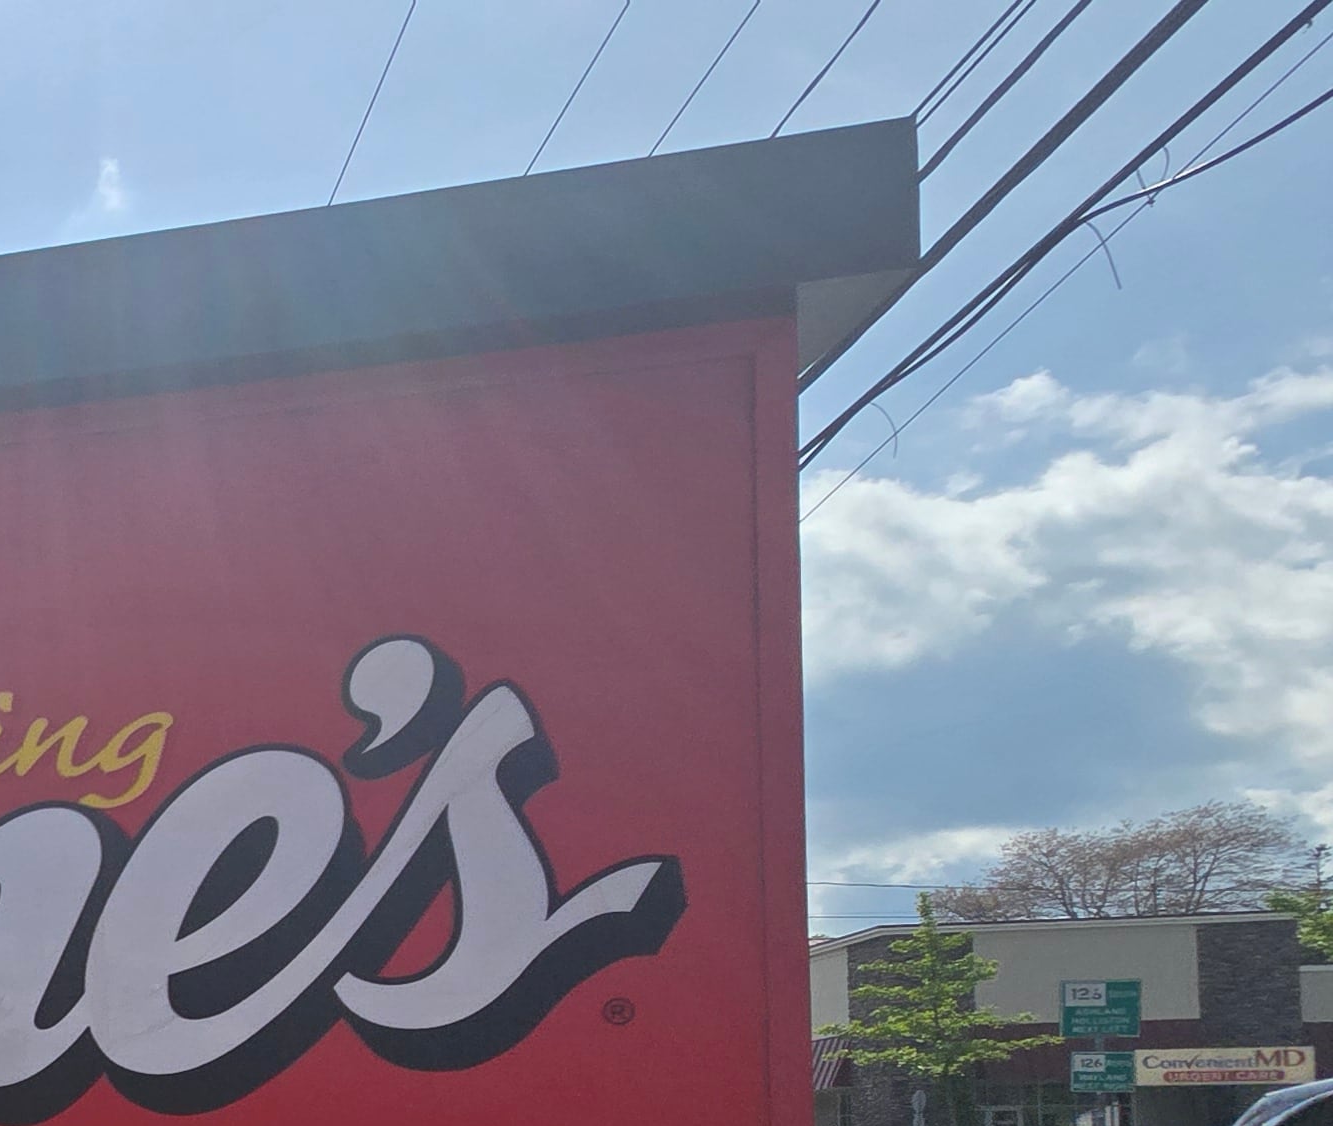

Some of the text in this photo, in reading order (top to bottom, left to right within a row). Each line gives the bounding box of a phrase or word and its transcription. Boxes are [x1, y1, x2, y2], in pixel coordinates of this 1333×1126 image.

[1071, 986, 1102, 1001] 126
[1081, 1058, 1103, 1068] 126
[1235, 1070, 1279, 1081] CARE
